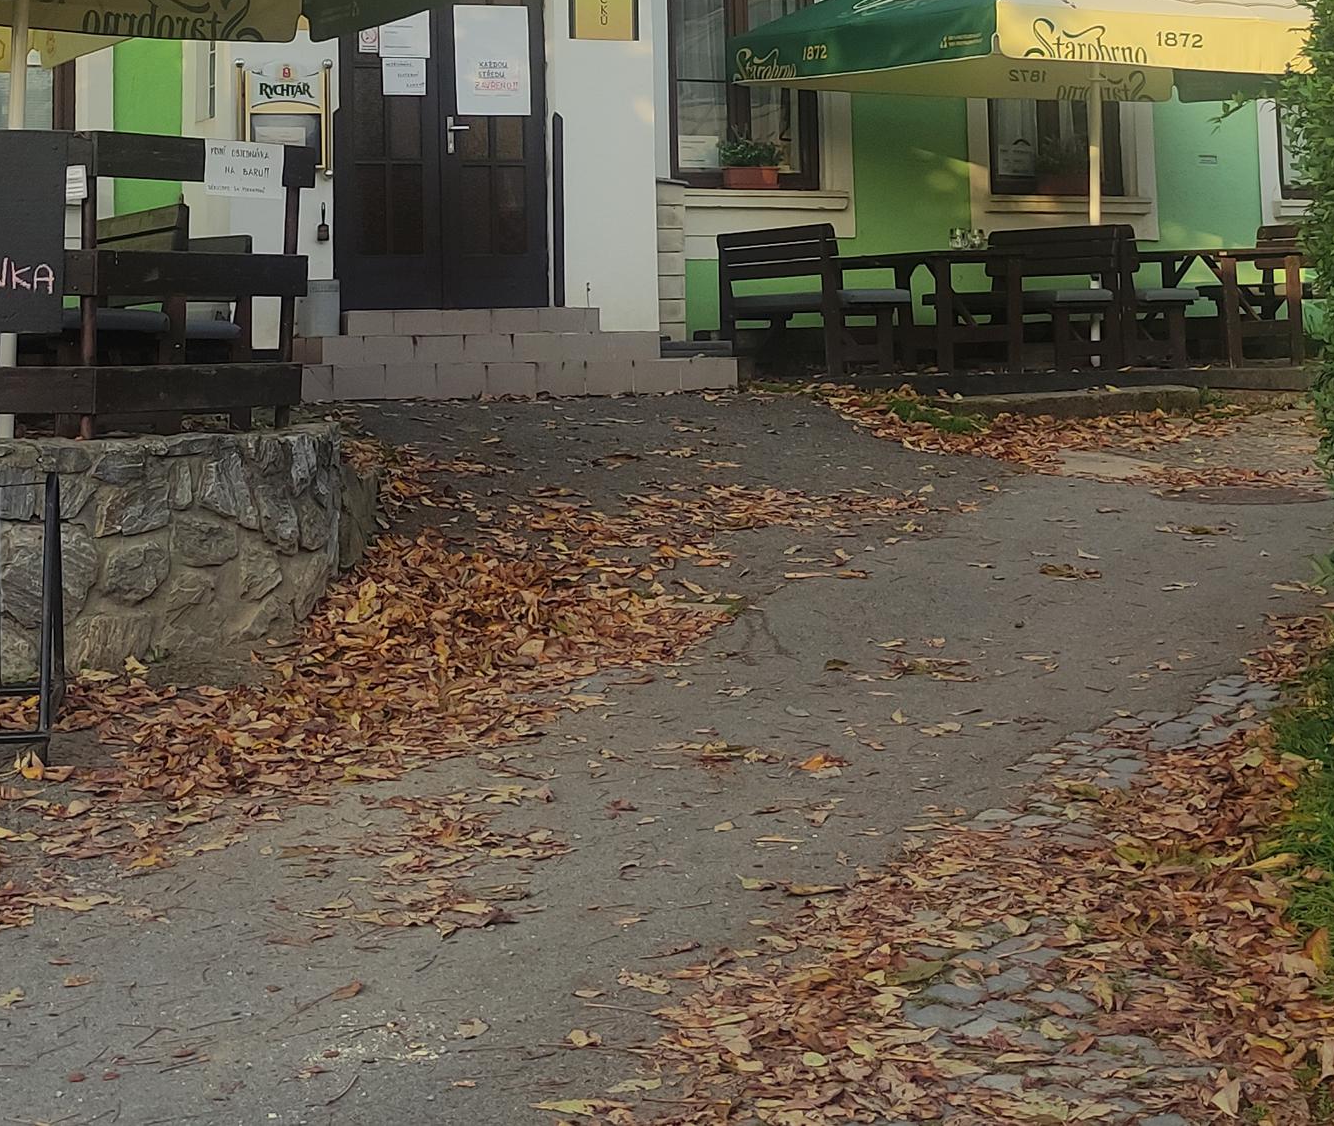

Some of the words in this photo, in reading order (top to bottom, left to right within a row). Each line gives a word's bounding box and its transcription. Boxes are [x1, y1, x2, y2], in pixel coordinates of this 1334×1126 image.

[1023, 17, 1148, 65] Starobrno
[1155, 30, 1204, 49] 1872
[802, 44, 828, 61] 1872
[224, 166, 236, 175] NA
